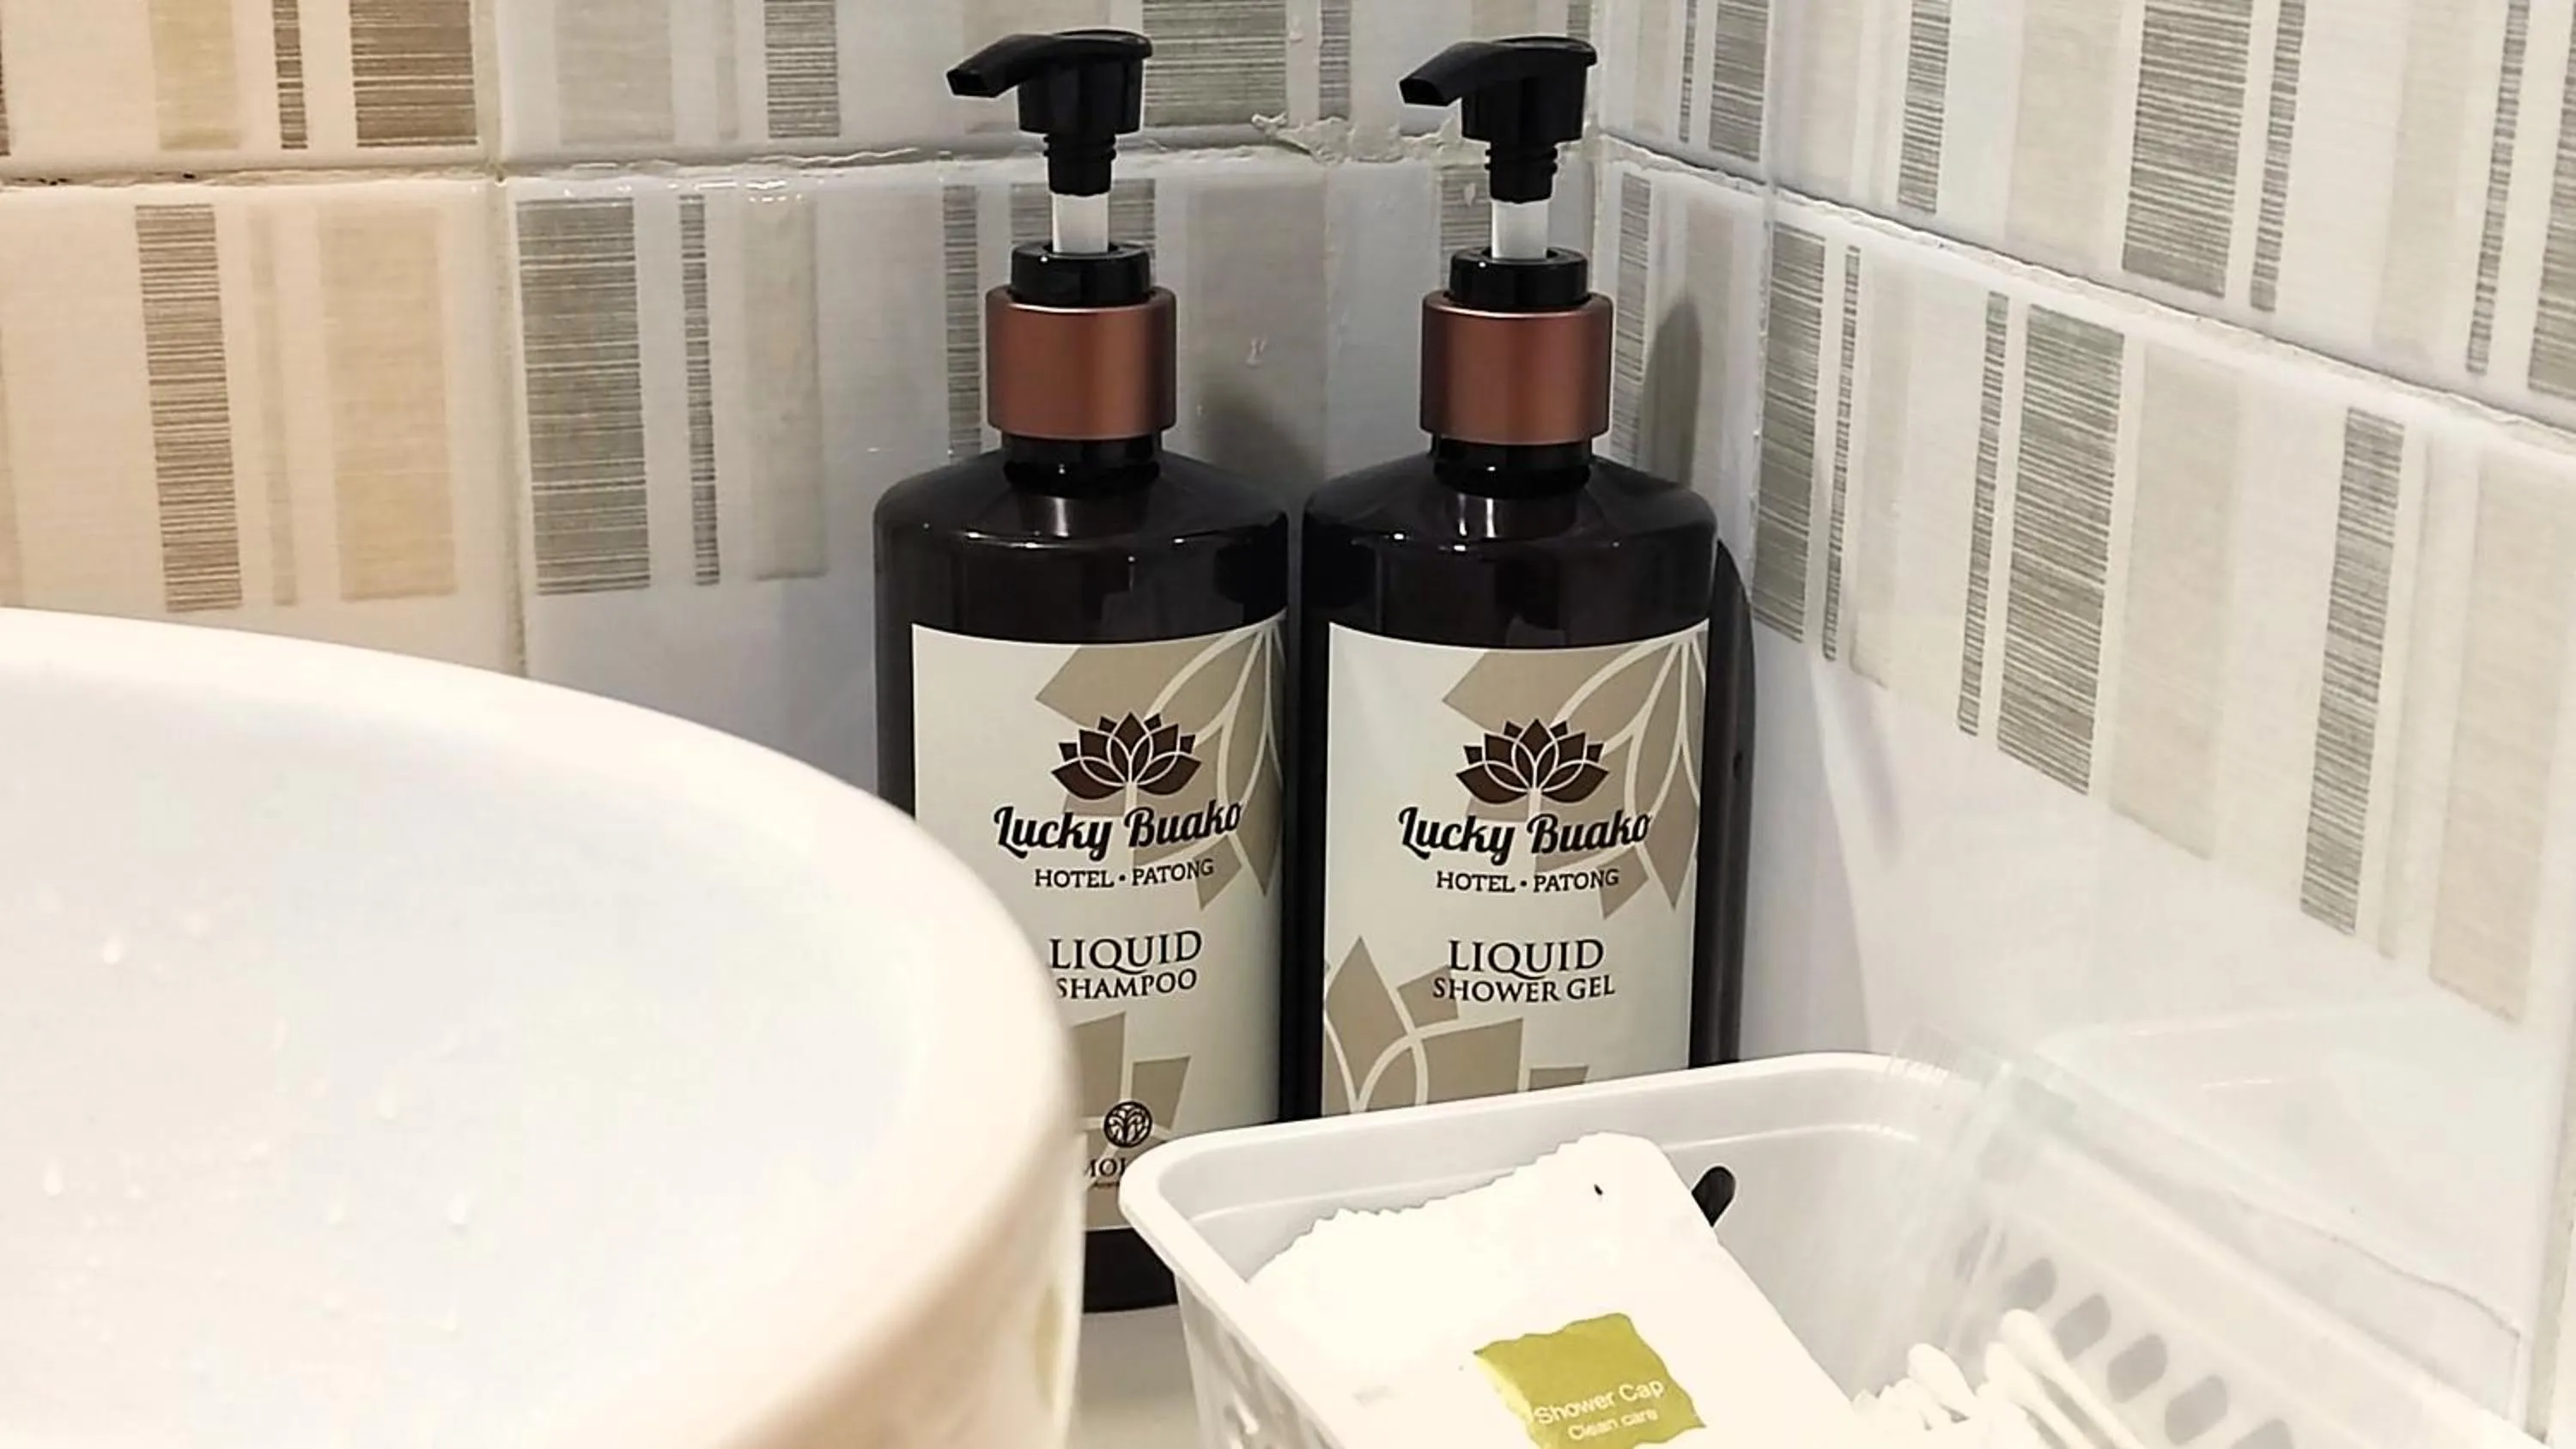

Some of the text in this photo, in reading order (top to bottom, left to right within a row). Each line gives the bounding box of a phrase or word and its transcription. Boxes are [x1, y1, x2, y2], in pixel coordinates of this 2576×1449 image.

[993, 799, 1243, 862] Lucky Buako
[1398, 806, 1653, 865] Lucky Buako
[1035, 858, 1214, 888] HOTEL PATONG
[1436, 869, 1619, 893] HOTEL PATONG
[1048, 930, 1202, 975] LIQUID
[1448, 938, 1604, 980] LIQUID
[1057, 968, 1197, 999] SHAMPOO
[1432, 974, 1615, 1003] SHOWER GEL
[1533, 1379, 1665, 1425] Shower Cap
[1567, 1408, 1659, 1440] Clean care
